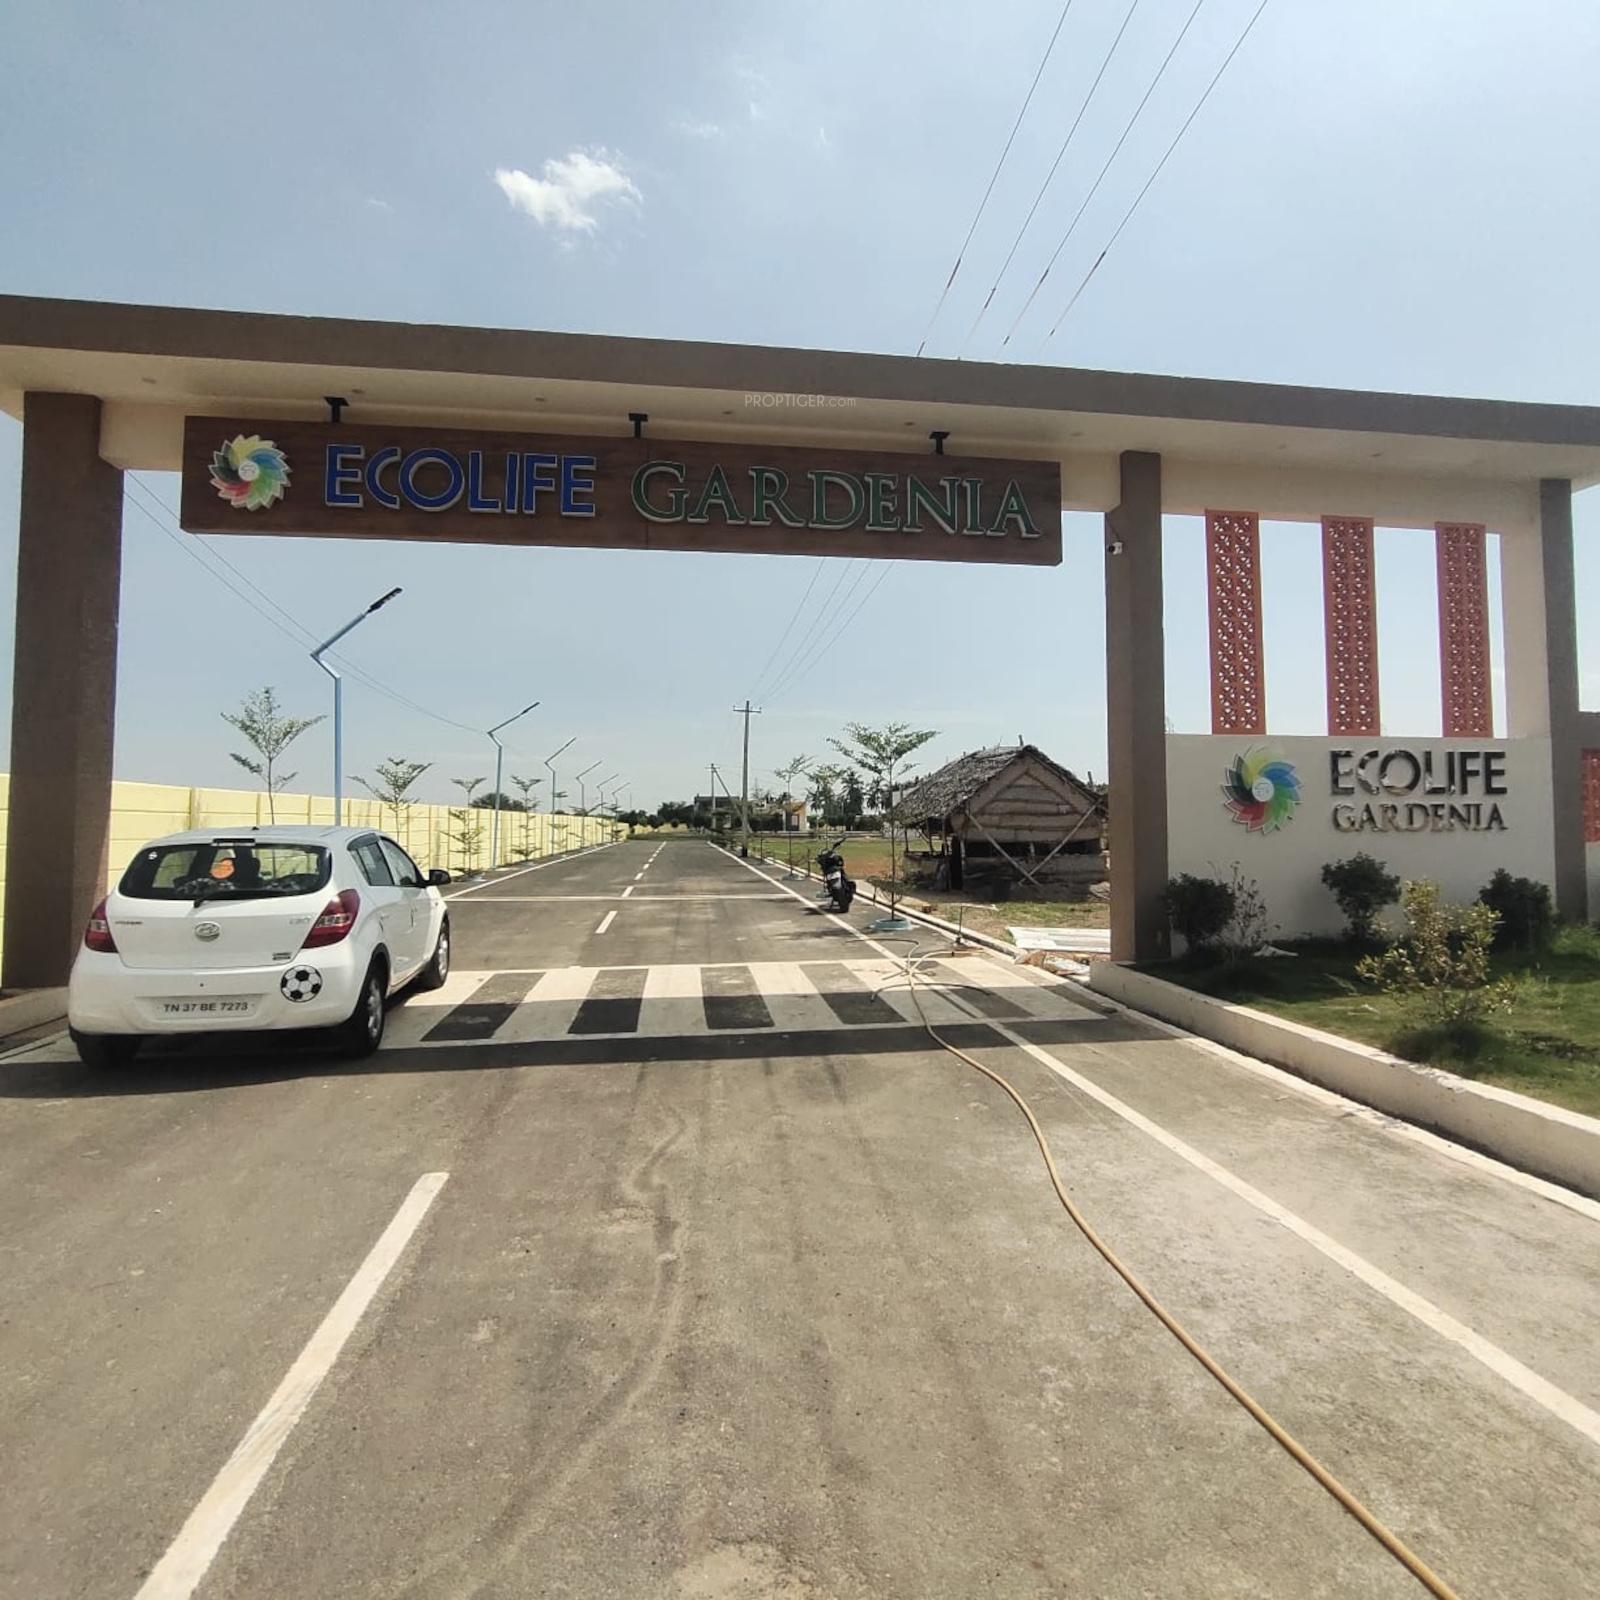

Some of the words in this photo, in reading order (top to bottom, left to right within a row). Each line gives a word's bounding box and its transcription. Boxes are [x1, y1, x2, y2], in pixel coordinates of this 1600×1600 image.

[325, 444, 597, 518] ECOLIFE
[631, 460, 1042, 539] GARDENIA
[1330, 749, 1508, 796] ECOLIFE
[1331, 801, 1509, 833] GARDENIA
[163, 1003, 180, 1013] TN
[182, 1003, 198, 1012] 37
[199, 1002, 217, 1012] BE
[220, 1001, 249, 1011] 7273
